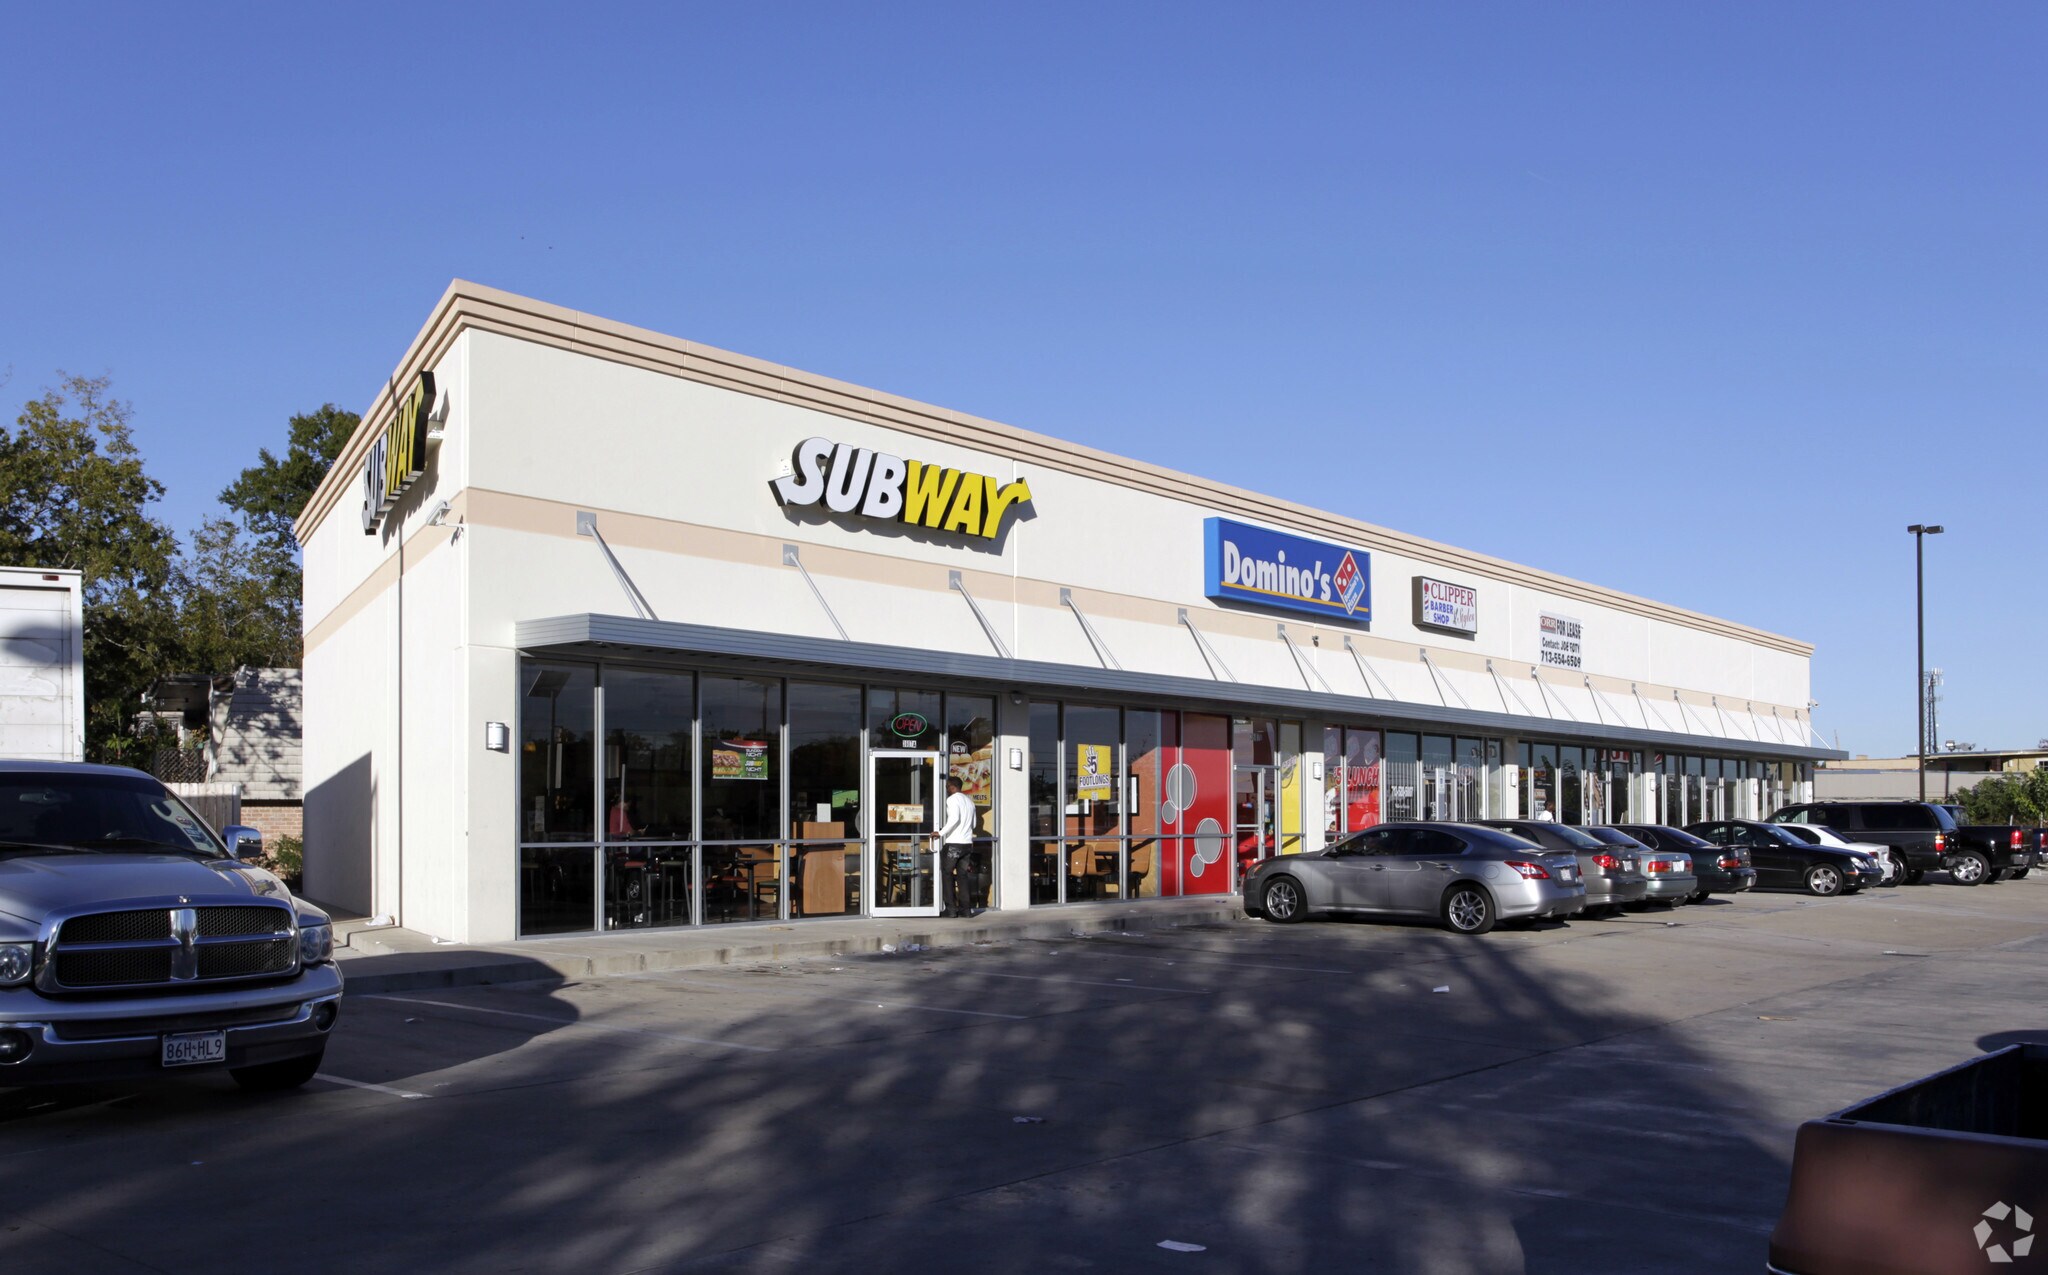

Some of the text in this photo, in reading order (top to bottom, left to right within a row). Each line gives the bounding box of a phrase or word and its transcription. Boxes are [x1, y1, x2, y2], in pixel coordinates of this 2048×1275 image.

[362, 372, 428, 531] SUBWAY
[768, 437, 1032, 539] SUBWAY
[1223, 540, 1332, 602] Domino's
[1430, 582, 1474, 608] CLIPPER
[1430, 600, 1454, 615] BARBER
[1433, 612, 1450, 625] SHOP
[1556, 619, 1581, 640] FOR LEASE
[895, 717, 922, 732] OPEN
[952, 745, 966, 753] NEW
[1080, 774, 1109, 787] FOOTLONGS
[1346, 765, 1380, 787] LUNCH
